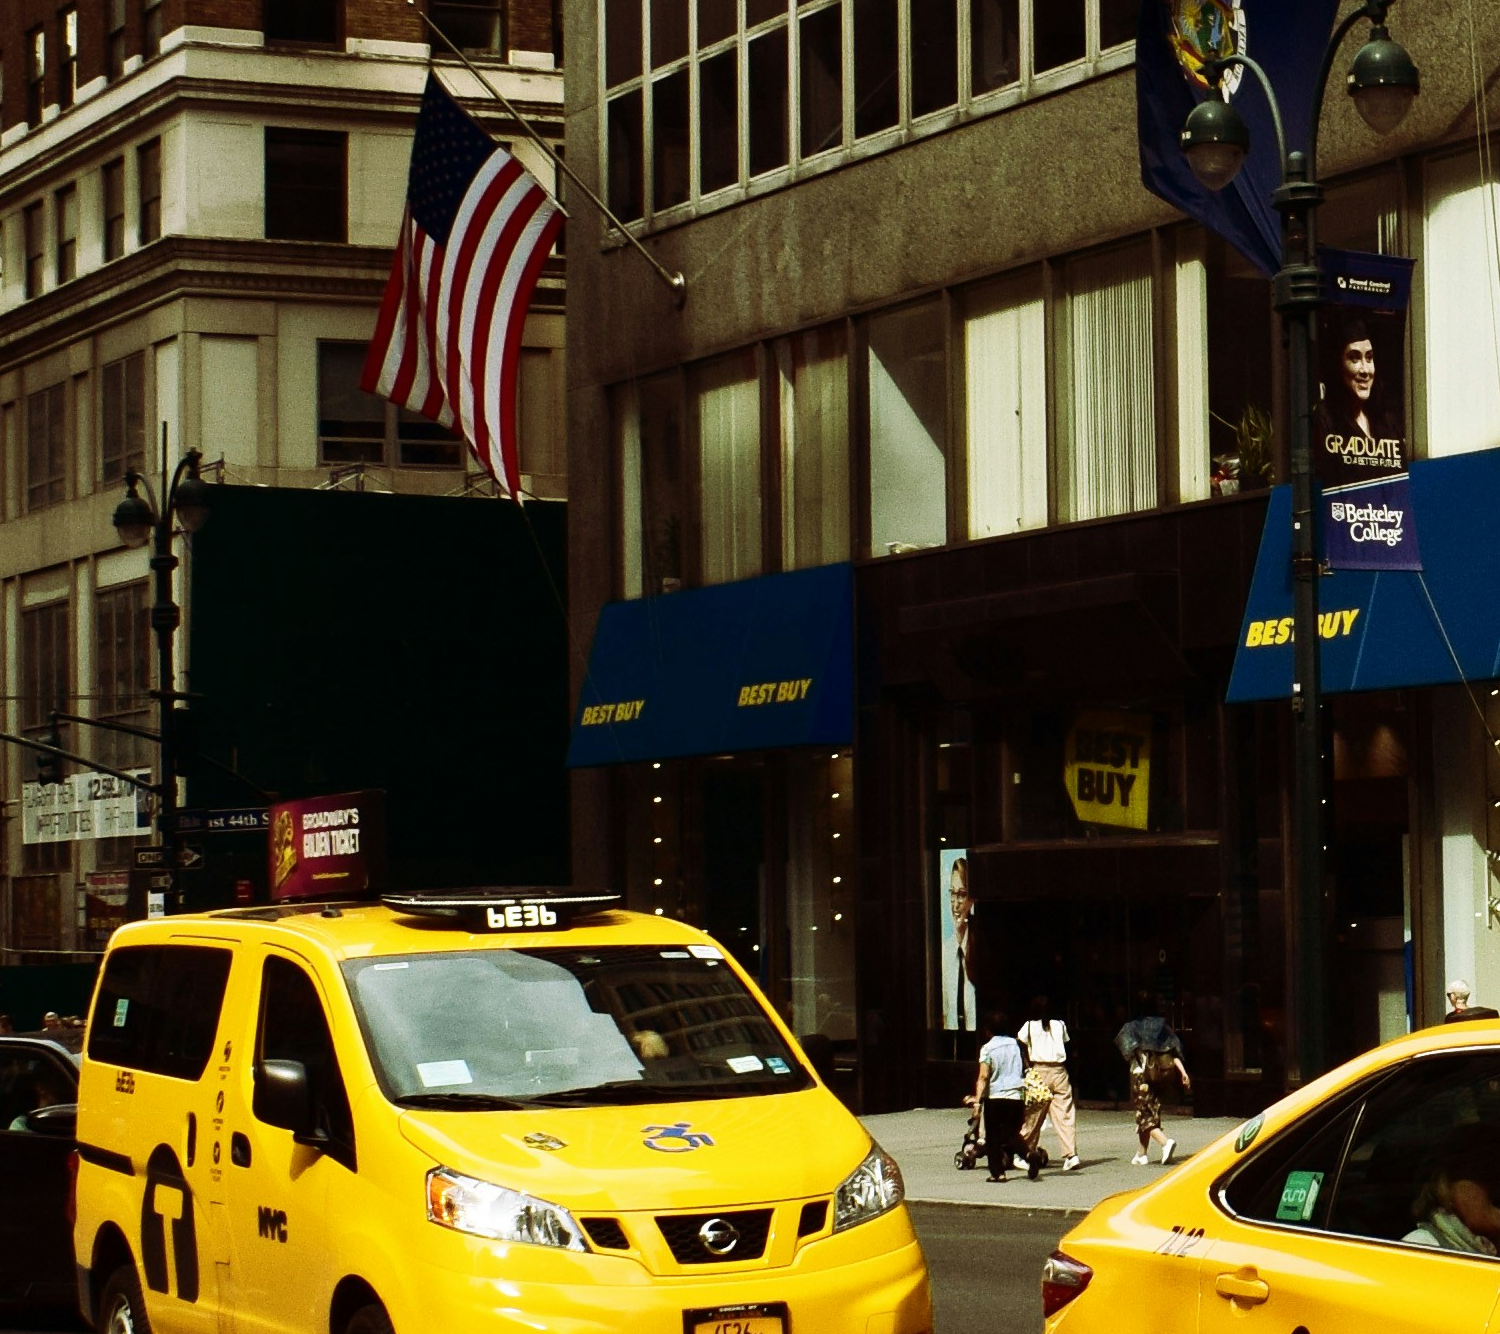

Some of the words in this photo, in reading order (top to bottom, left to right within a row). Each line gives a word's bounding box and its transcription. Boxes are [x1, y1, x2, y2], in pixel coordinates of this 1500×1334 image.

[1325, 434, 1402, 458] GRADUATE
[1345, 503, 1404, 528] Berkeley
[1350, 522, 1402, 546] College
[1246, 617, 1295, 647] BES
[737, 683, 777, 707] BEST
[776, 678, 812, 703] BUY
[581, 705, 616, 726] BEST
[614, 699, 645, 723] BUY
[1075, 731, 1144, 768] BEST
[1078, 768, 1137, 806] BUY
[228, 814, 257, 826] 44th
[258, 1206, 288, 1243] NYC
